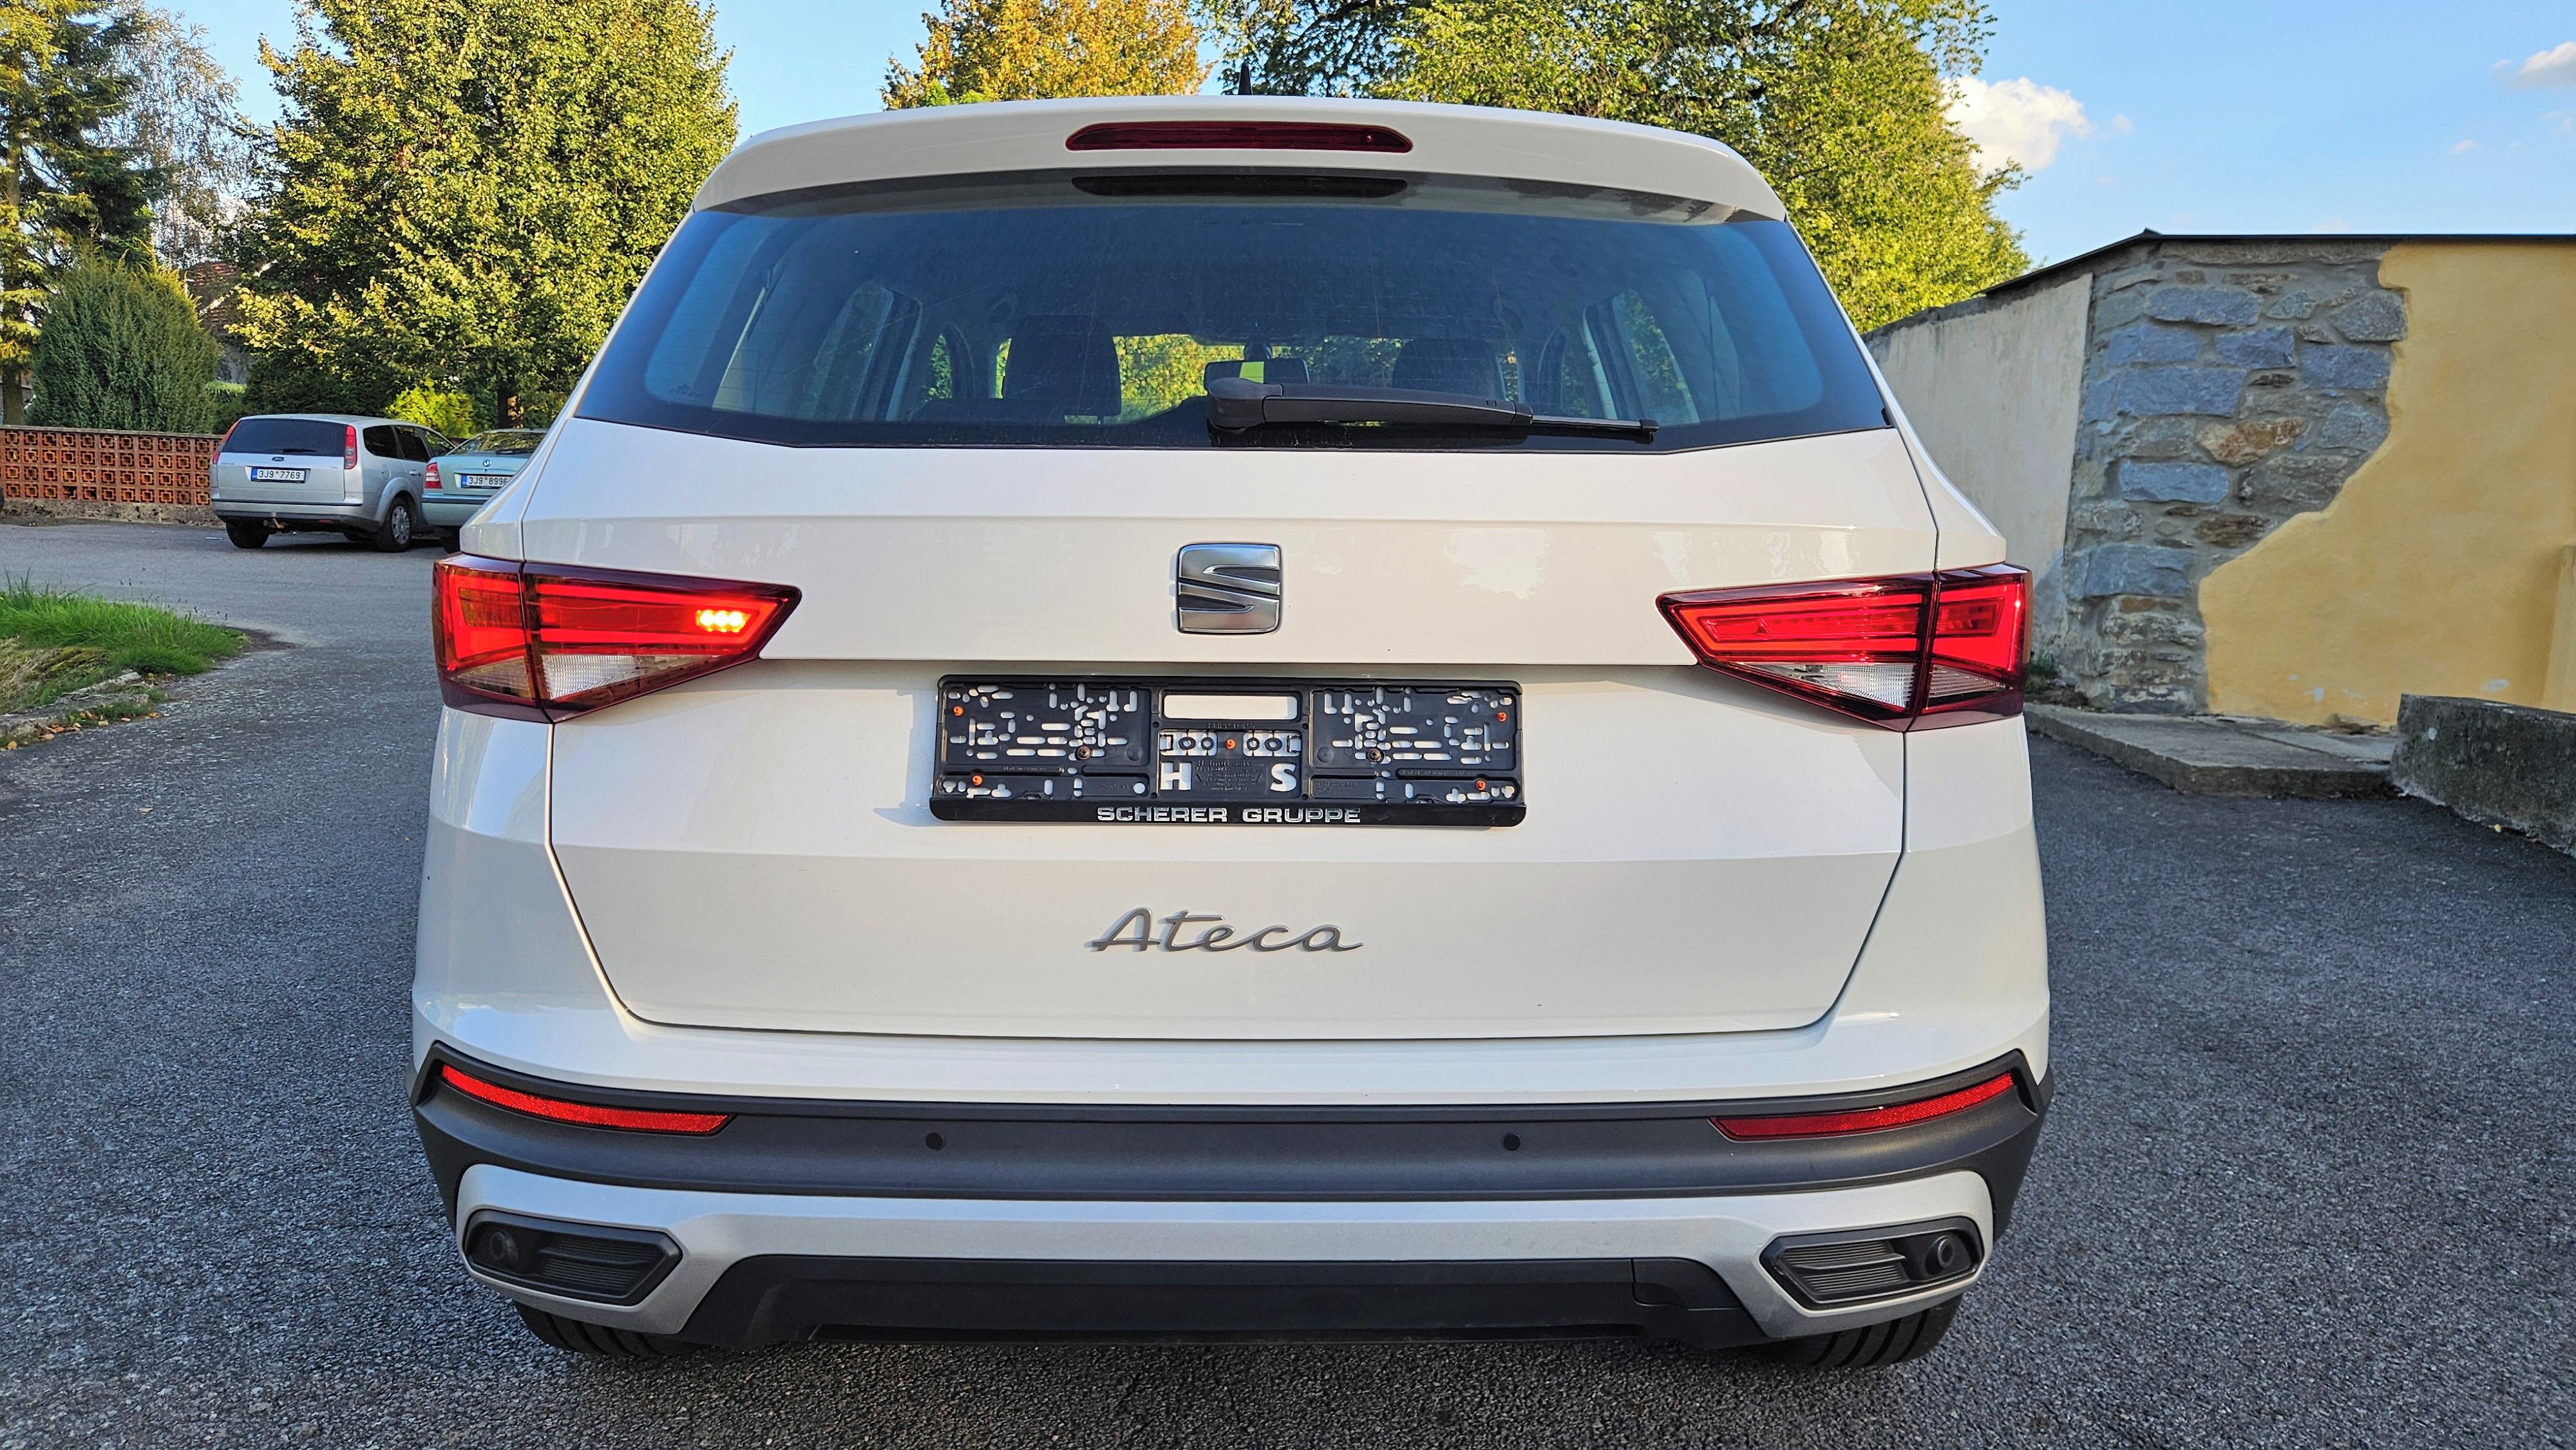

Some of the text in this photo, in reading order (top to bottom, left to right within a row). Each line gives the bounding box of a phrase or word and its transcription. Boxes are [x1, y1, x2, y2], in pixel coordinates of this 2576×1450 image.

[259, 470, 274, 478] 3J9
[280, 471, 301, 479] 7769
[468, 476, 483, 485] 3J9
[1097, 806, 1361, 824] SCHERER GRUPPE
[1092, 907, 1364, 952] Ateca
